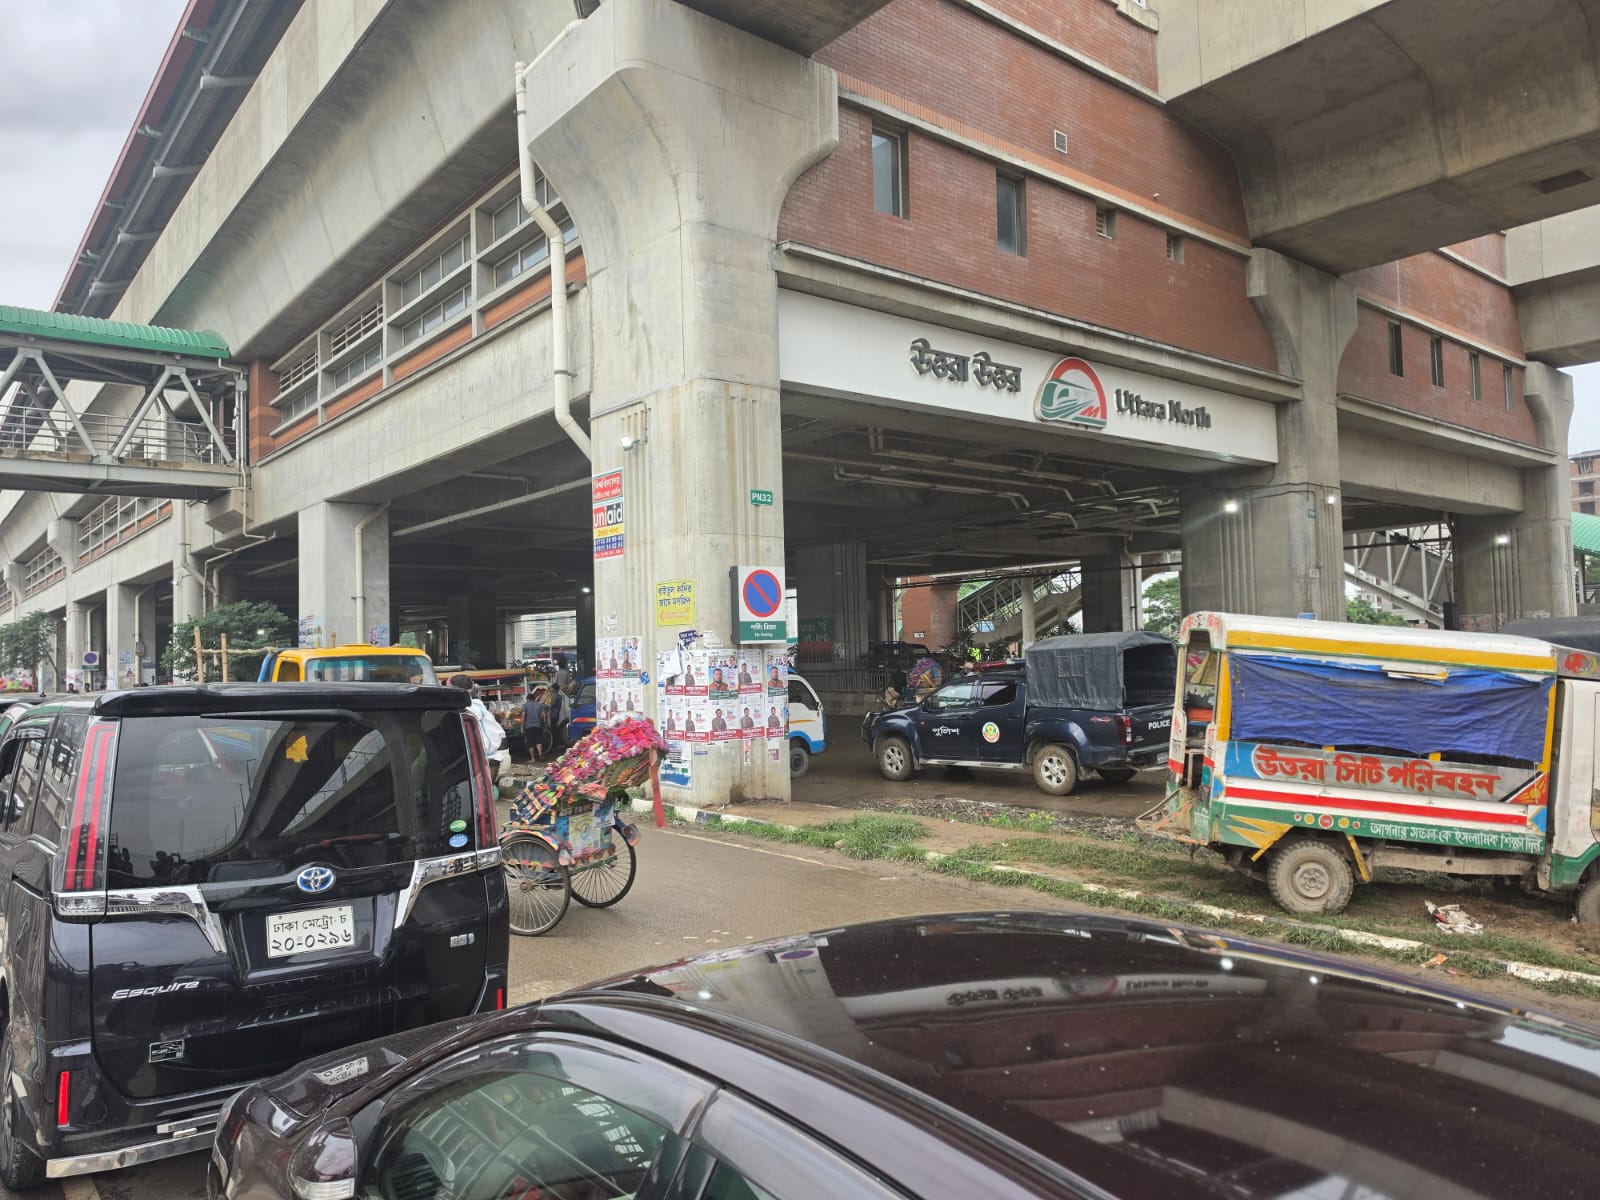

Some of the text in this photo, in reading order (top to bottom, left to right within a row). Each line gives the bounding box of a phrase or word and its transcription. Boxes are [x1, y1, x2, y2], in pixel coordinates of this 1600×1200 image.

[910, 338, 1022, 393] উত্তরা উত্তর
[1114, 388, 1212, 428] Uttara North
[751, 492, 771, 502] PN32
[593, 503, 623, 528] uniaid
[931, 725, 960, 737] পুলিশ
[1148, 719, 1171, 730] POLICE
[1255, 746, 1503, 796] উত্তরা সিটি পরিবহন
[273, 920, 299, 933] ঢাকা
[271, 929, 352, 952] ২০-০২৯৬
[111, 981, 200, 1000] Esquire
